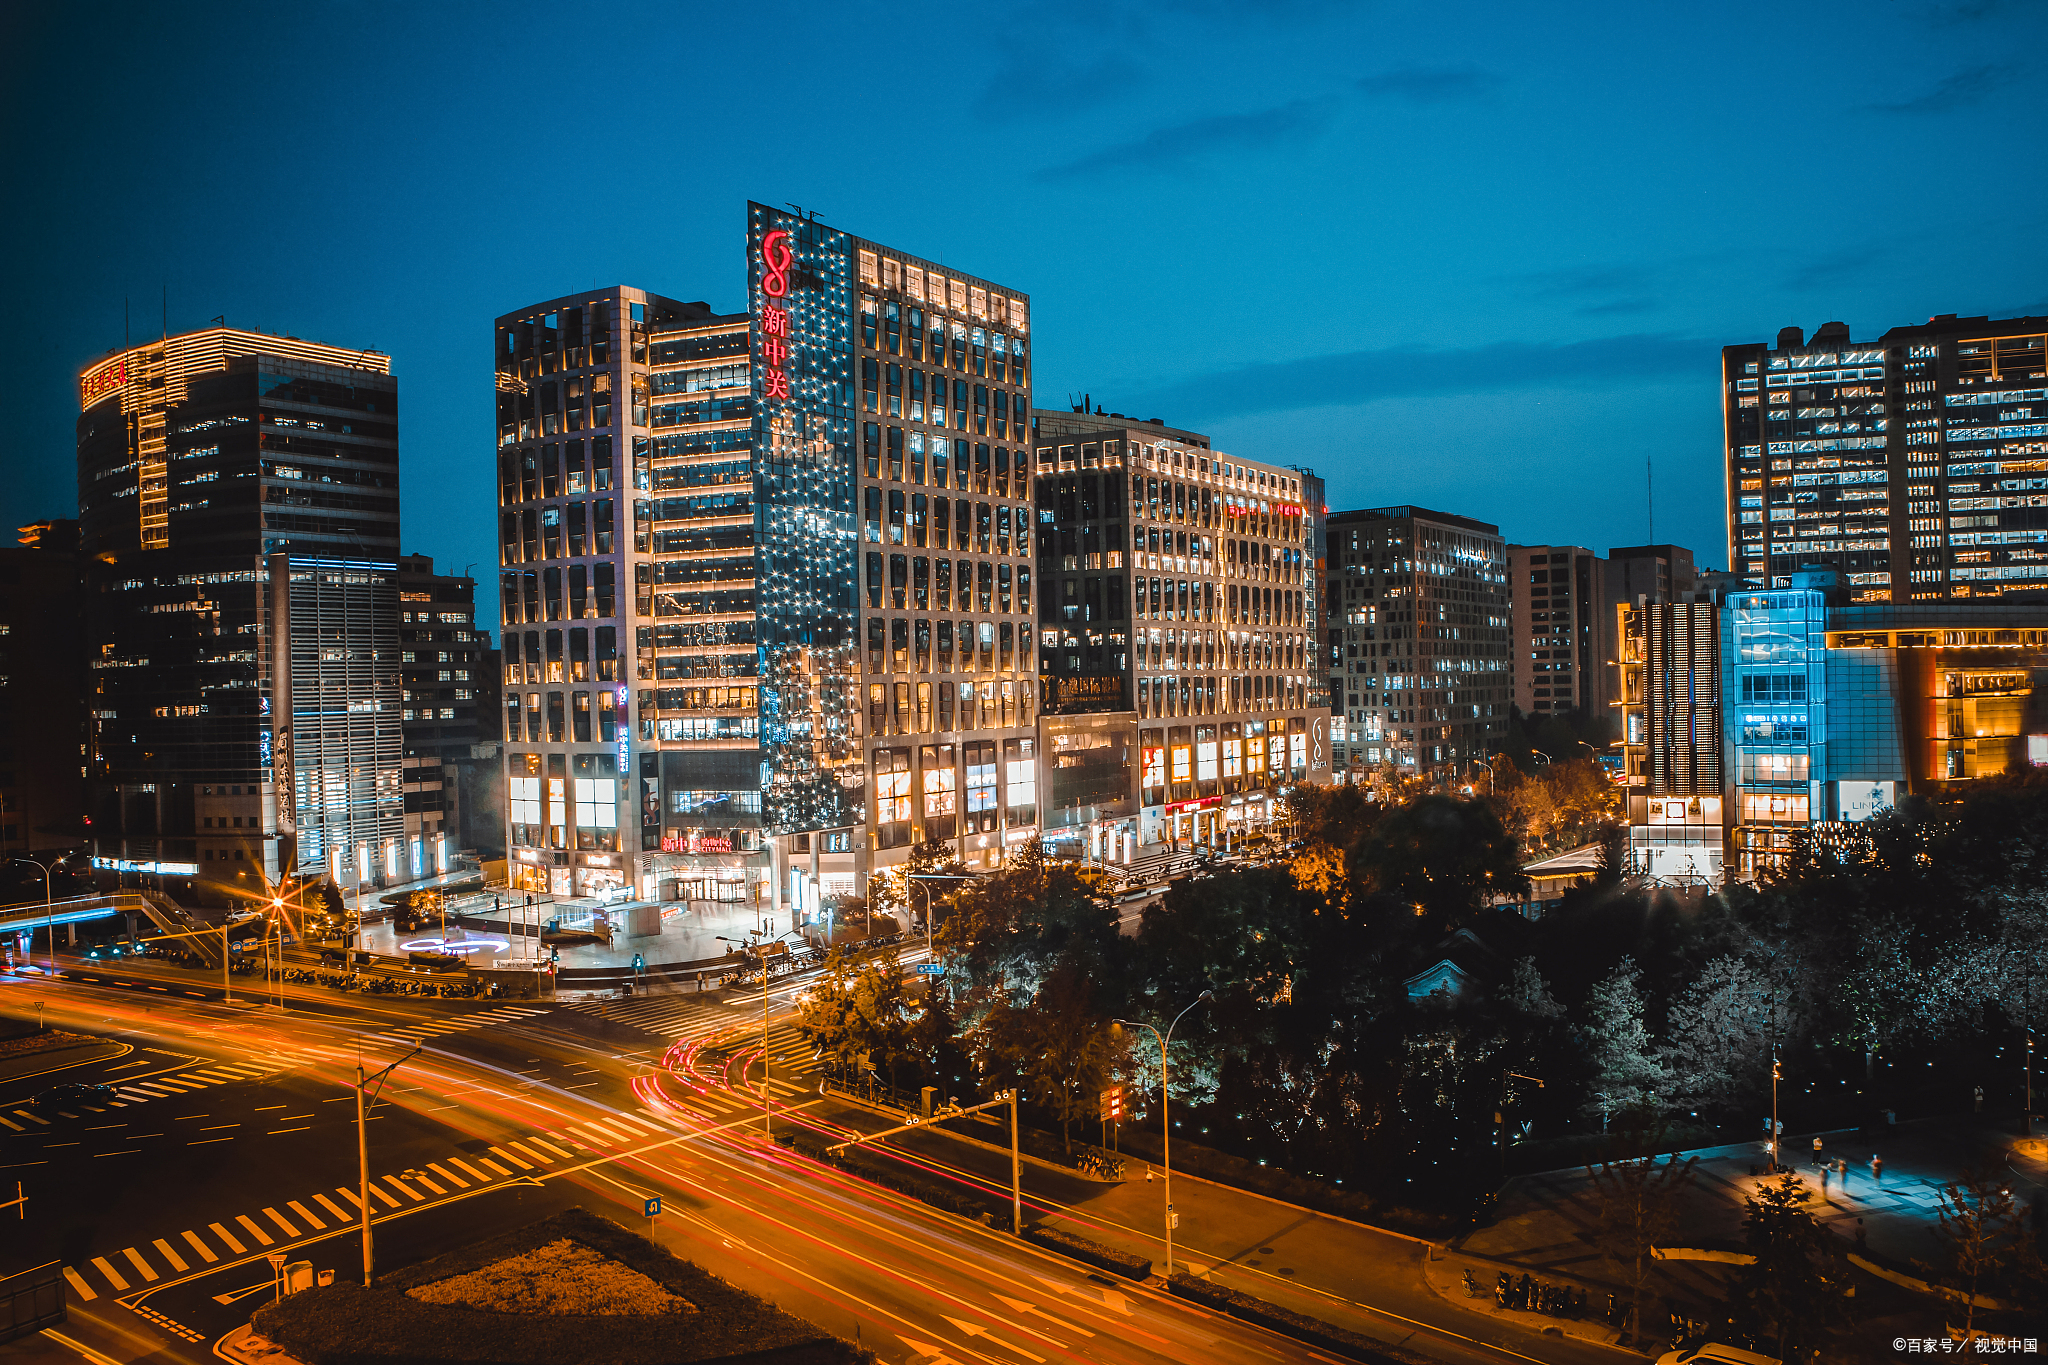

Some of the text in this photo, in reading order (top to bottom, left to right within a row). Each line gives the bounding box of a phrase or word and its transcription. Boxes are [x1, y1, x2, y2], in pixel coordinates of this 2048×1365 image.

[764, 305, 788, 399] 新中关
[1852, 801, 1883, 810] LINK
